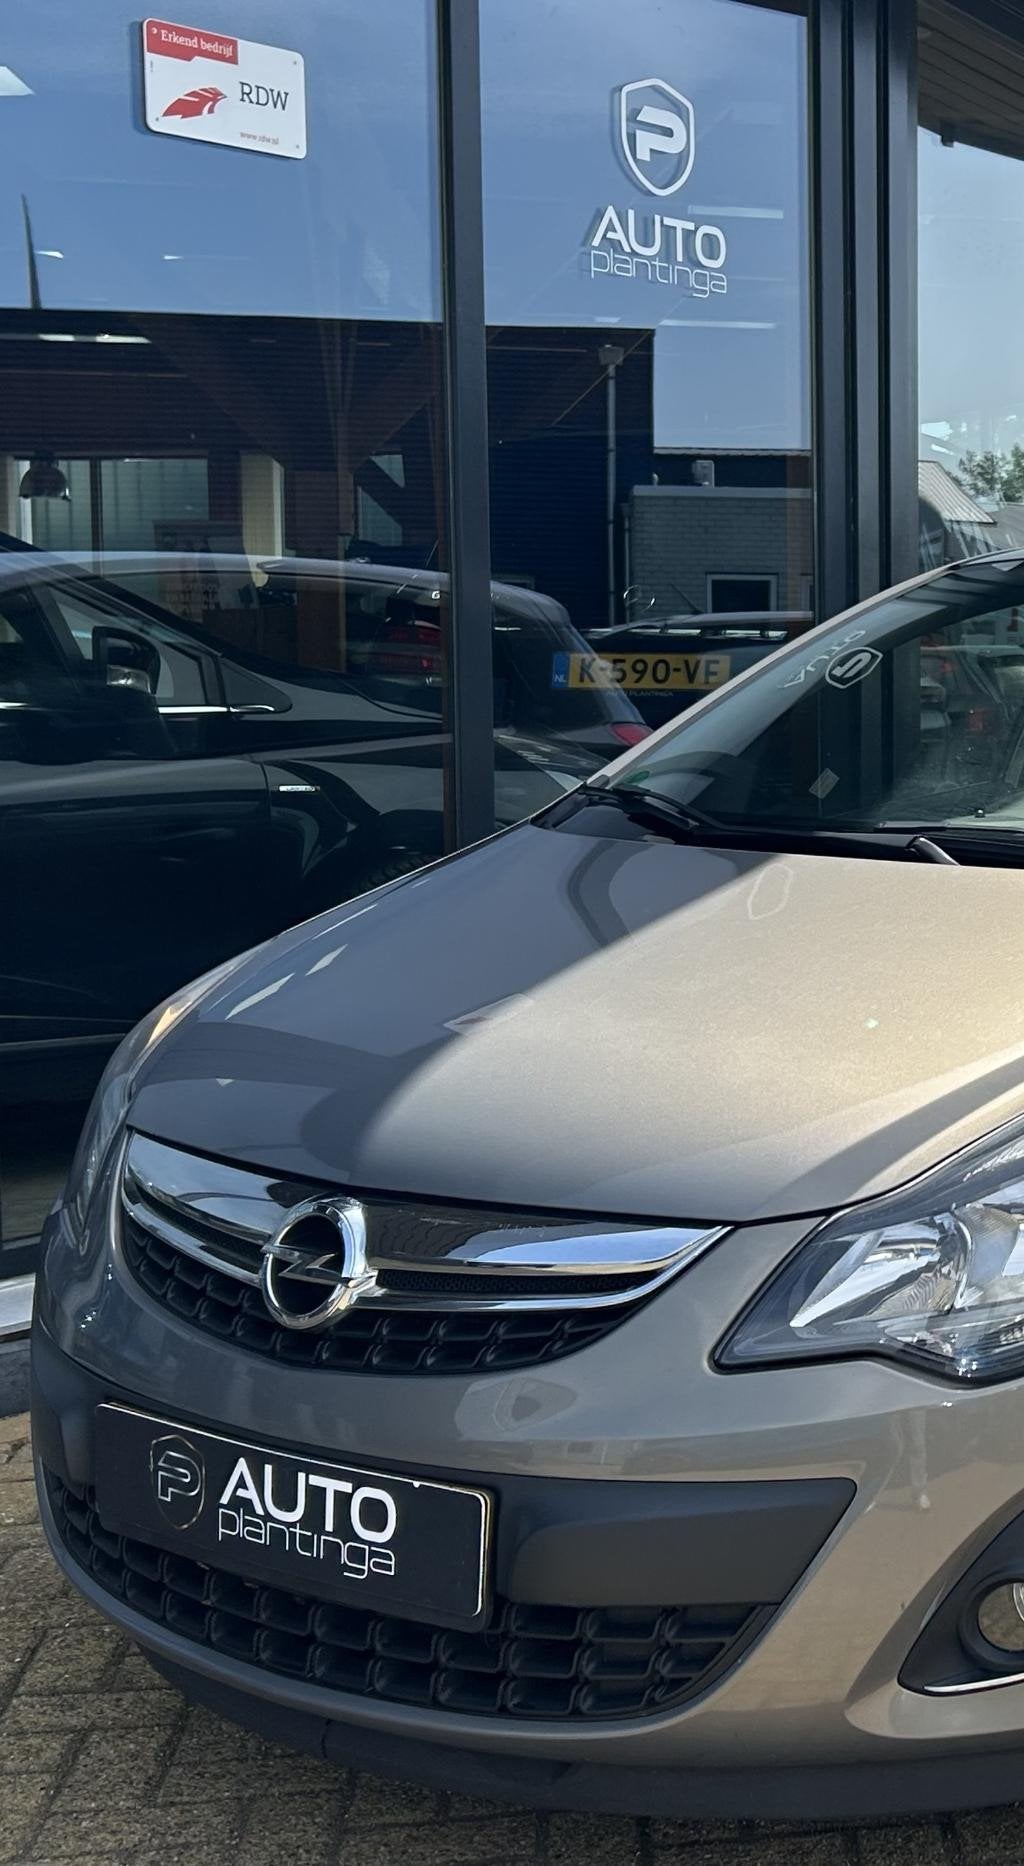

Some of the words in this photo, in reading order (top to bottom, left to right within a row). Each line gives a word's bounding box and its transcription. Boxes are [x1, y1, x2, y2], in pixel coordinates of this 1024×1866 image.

[161, 29, 198, 49] Erkend
[200, 38, 233, 58] bedrijf
[239, 81, 290, 112] RDW
[592, 205, 727, 269] AUTO
[590, 248, 728, 298] plantinga
[553, 674, 567, 684] NL
[218, 1456, 398, 1544] AUTO
[218, 1507, 396, 1580] plantinga
